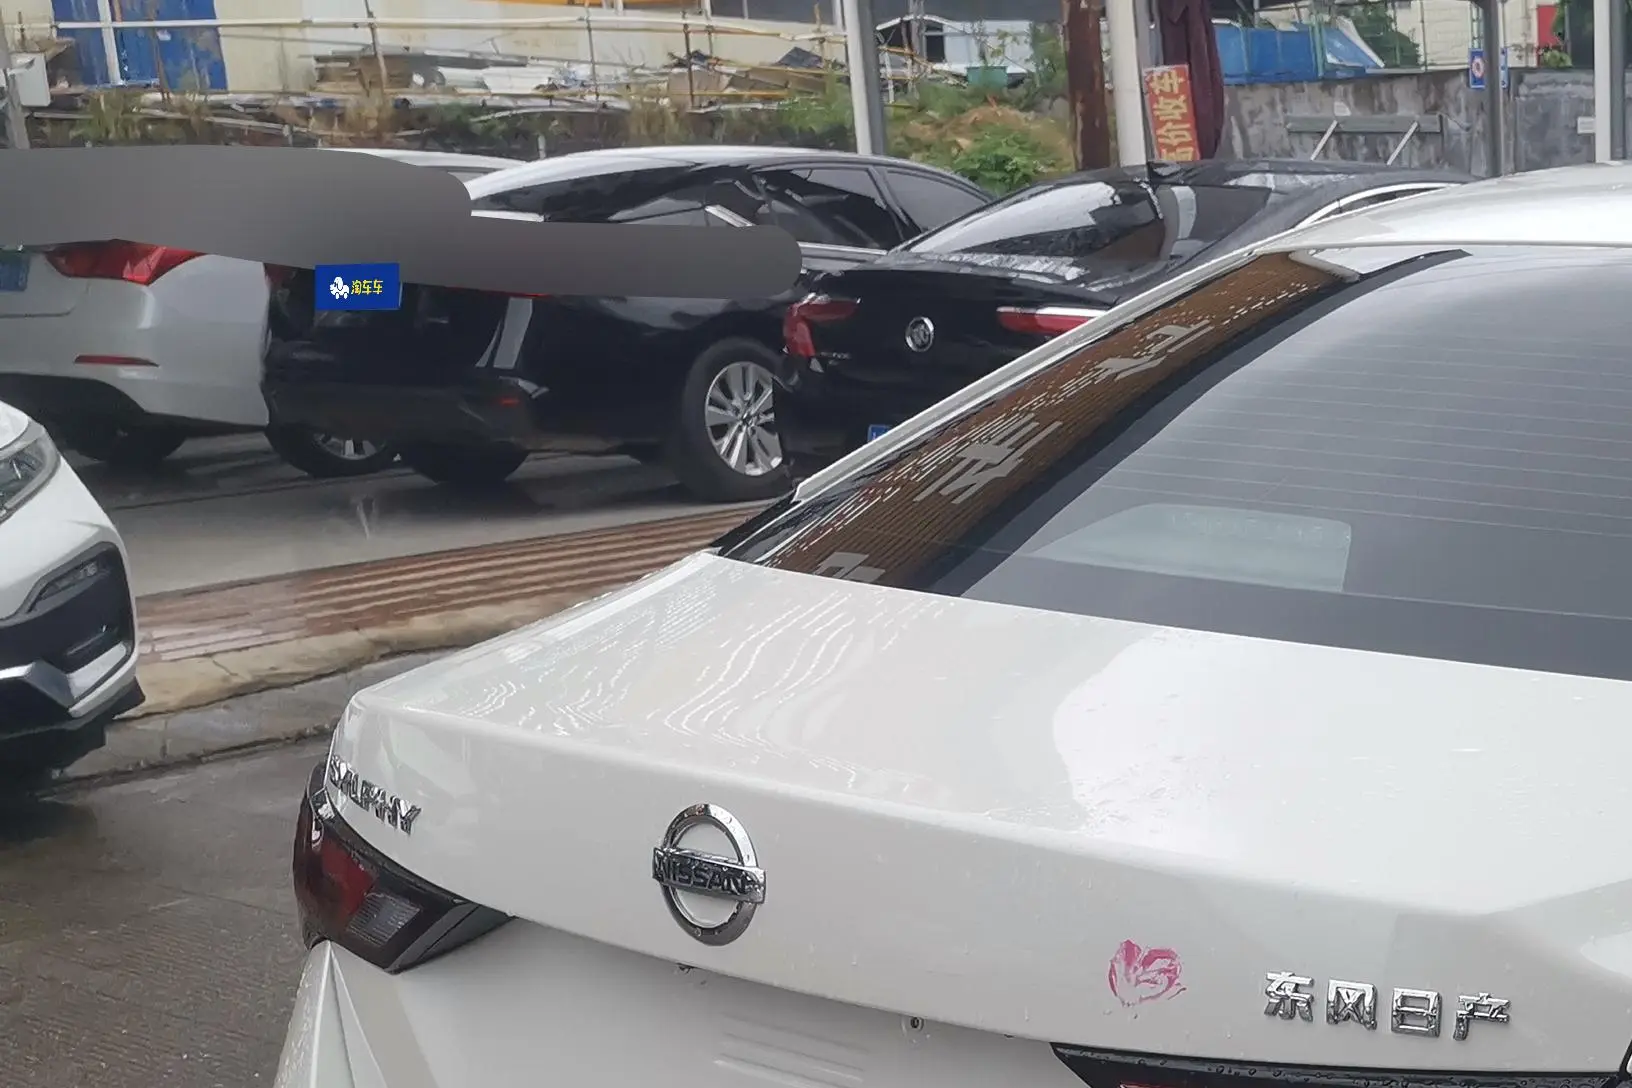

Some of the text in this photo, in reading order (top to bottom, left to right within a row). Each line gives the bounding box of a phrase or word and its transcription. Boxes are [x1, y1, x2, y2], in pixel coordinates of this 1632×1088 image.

[654, 851, 750, 896] NISSAN
[1264, 971, 1511, 1041] 东风日产
